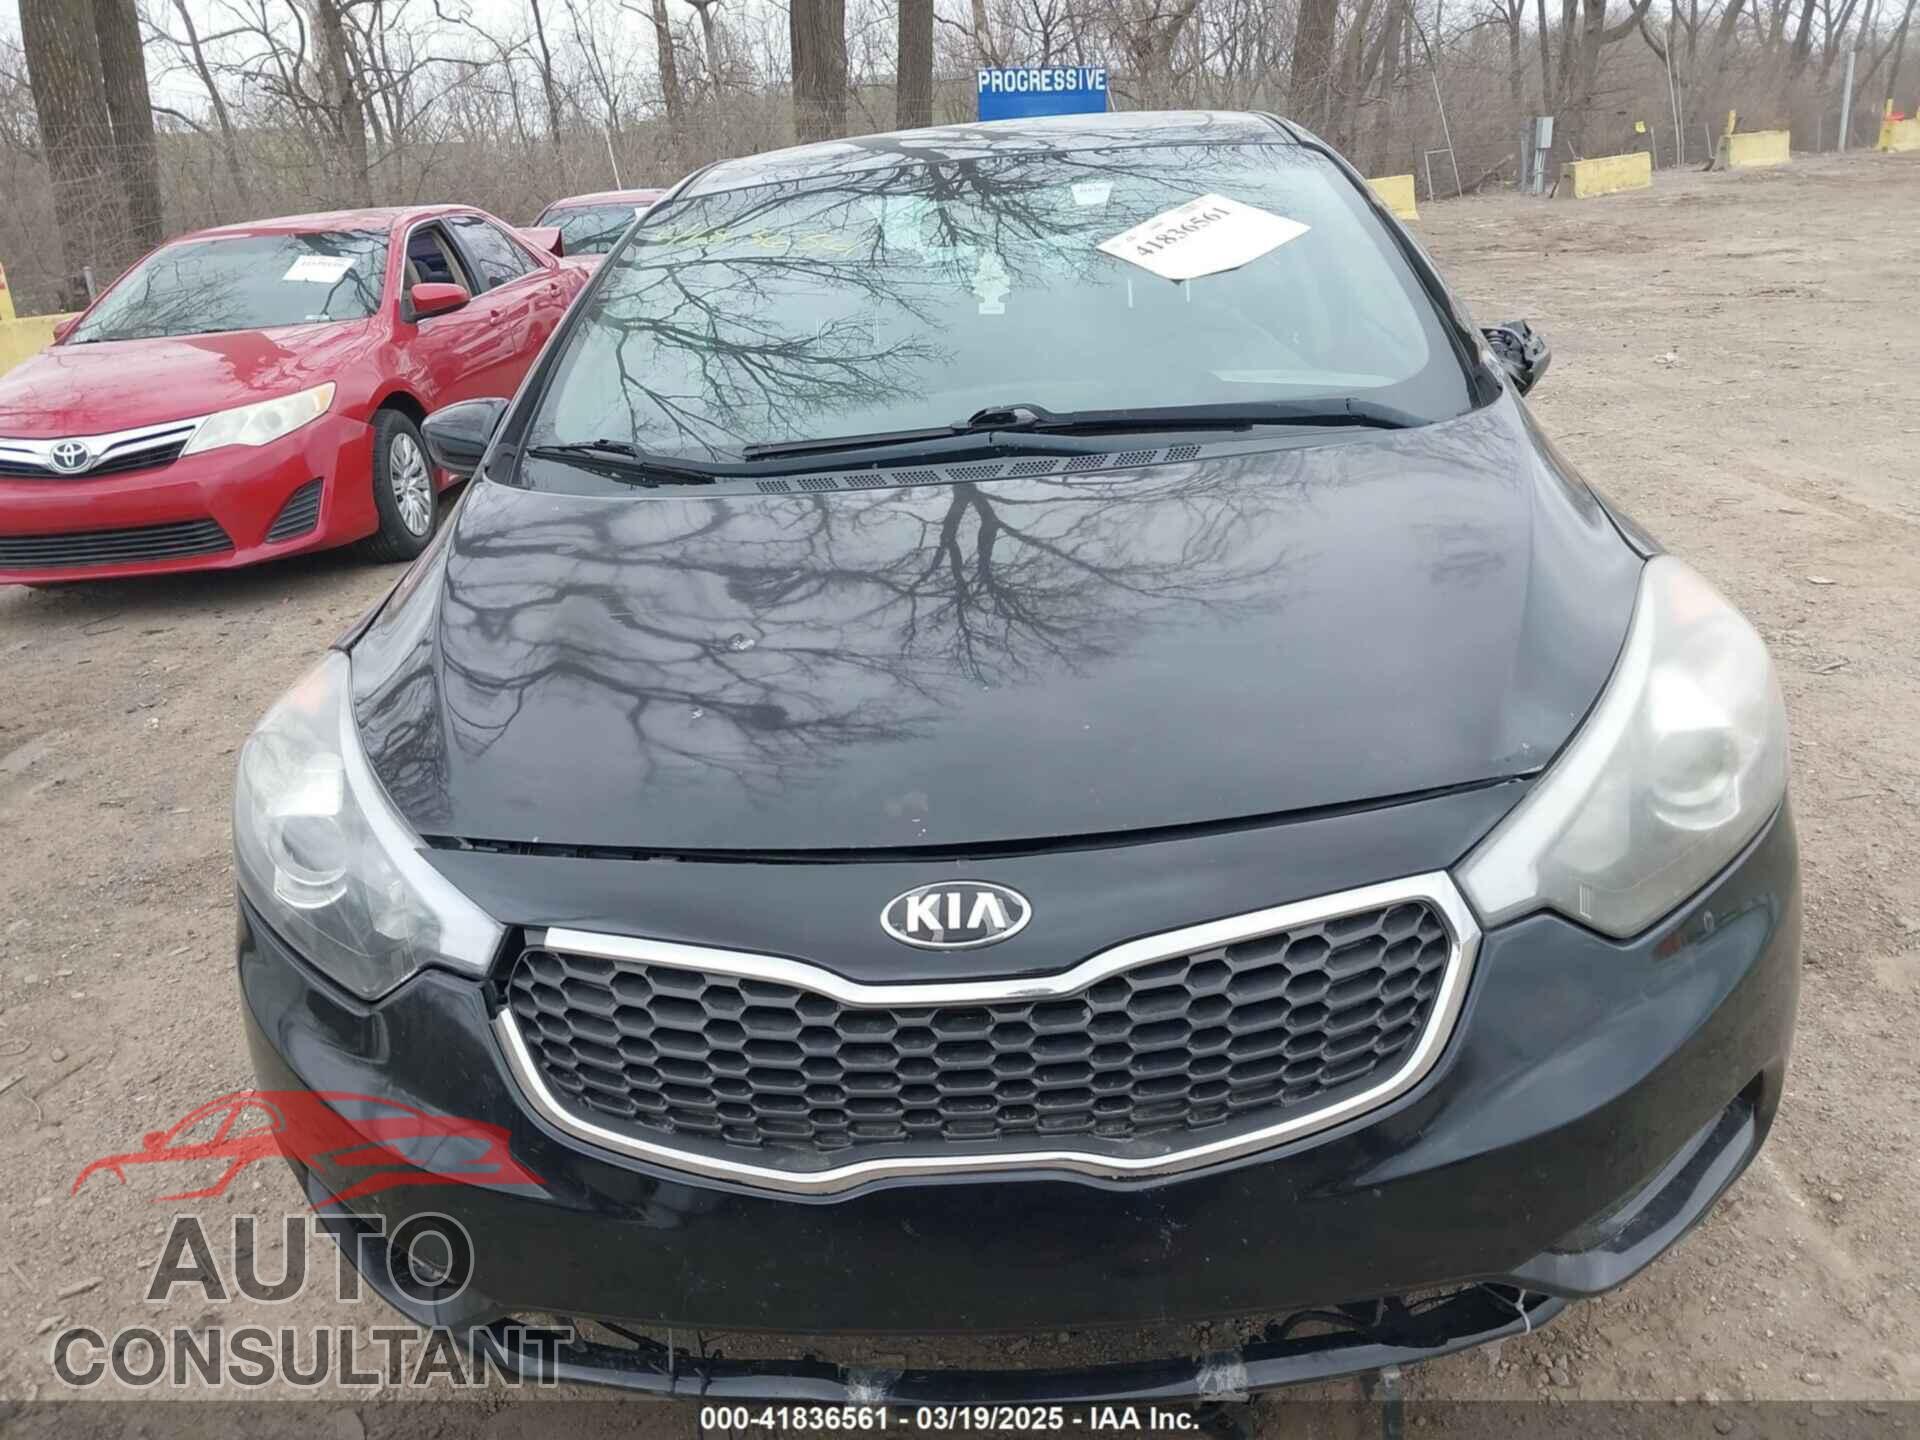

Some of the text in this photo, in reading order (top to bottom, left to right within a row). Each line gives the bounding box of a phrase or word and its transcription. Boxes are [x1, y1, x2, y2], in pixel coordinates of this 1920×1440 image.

[978, 68, 1106, 93] PROGRESSIVE
[1136, 206, 1231, 256] 41836561
[906, 891, 1006, 933] KIA
